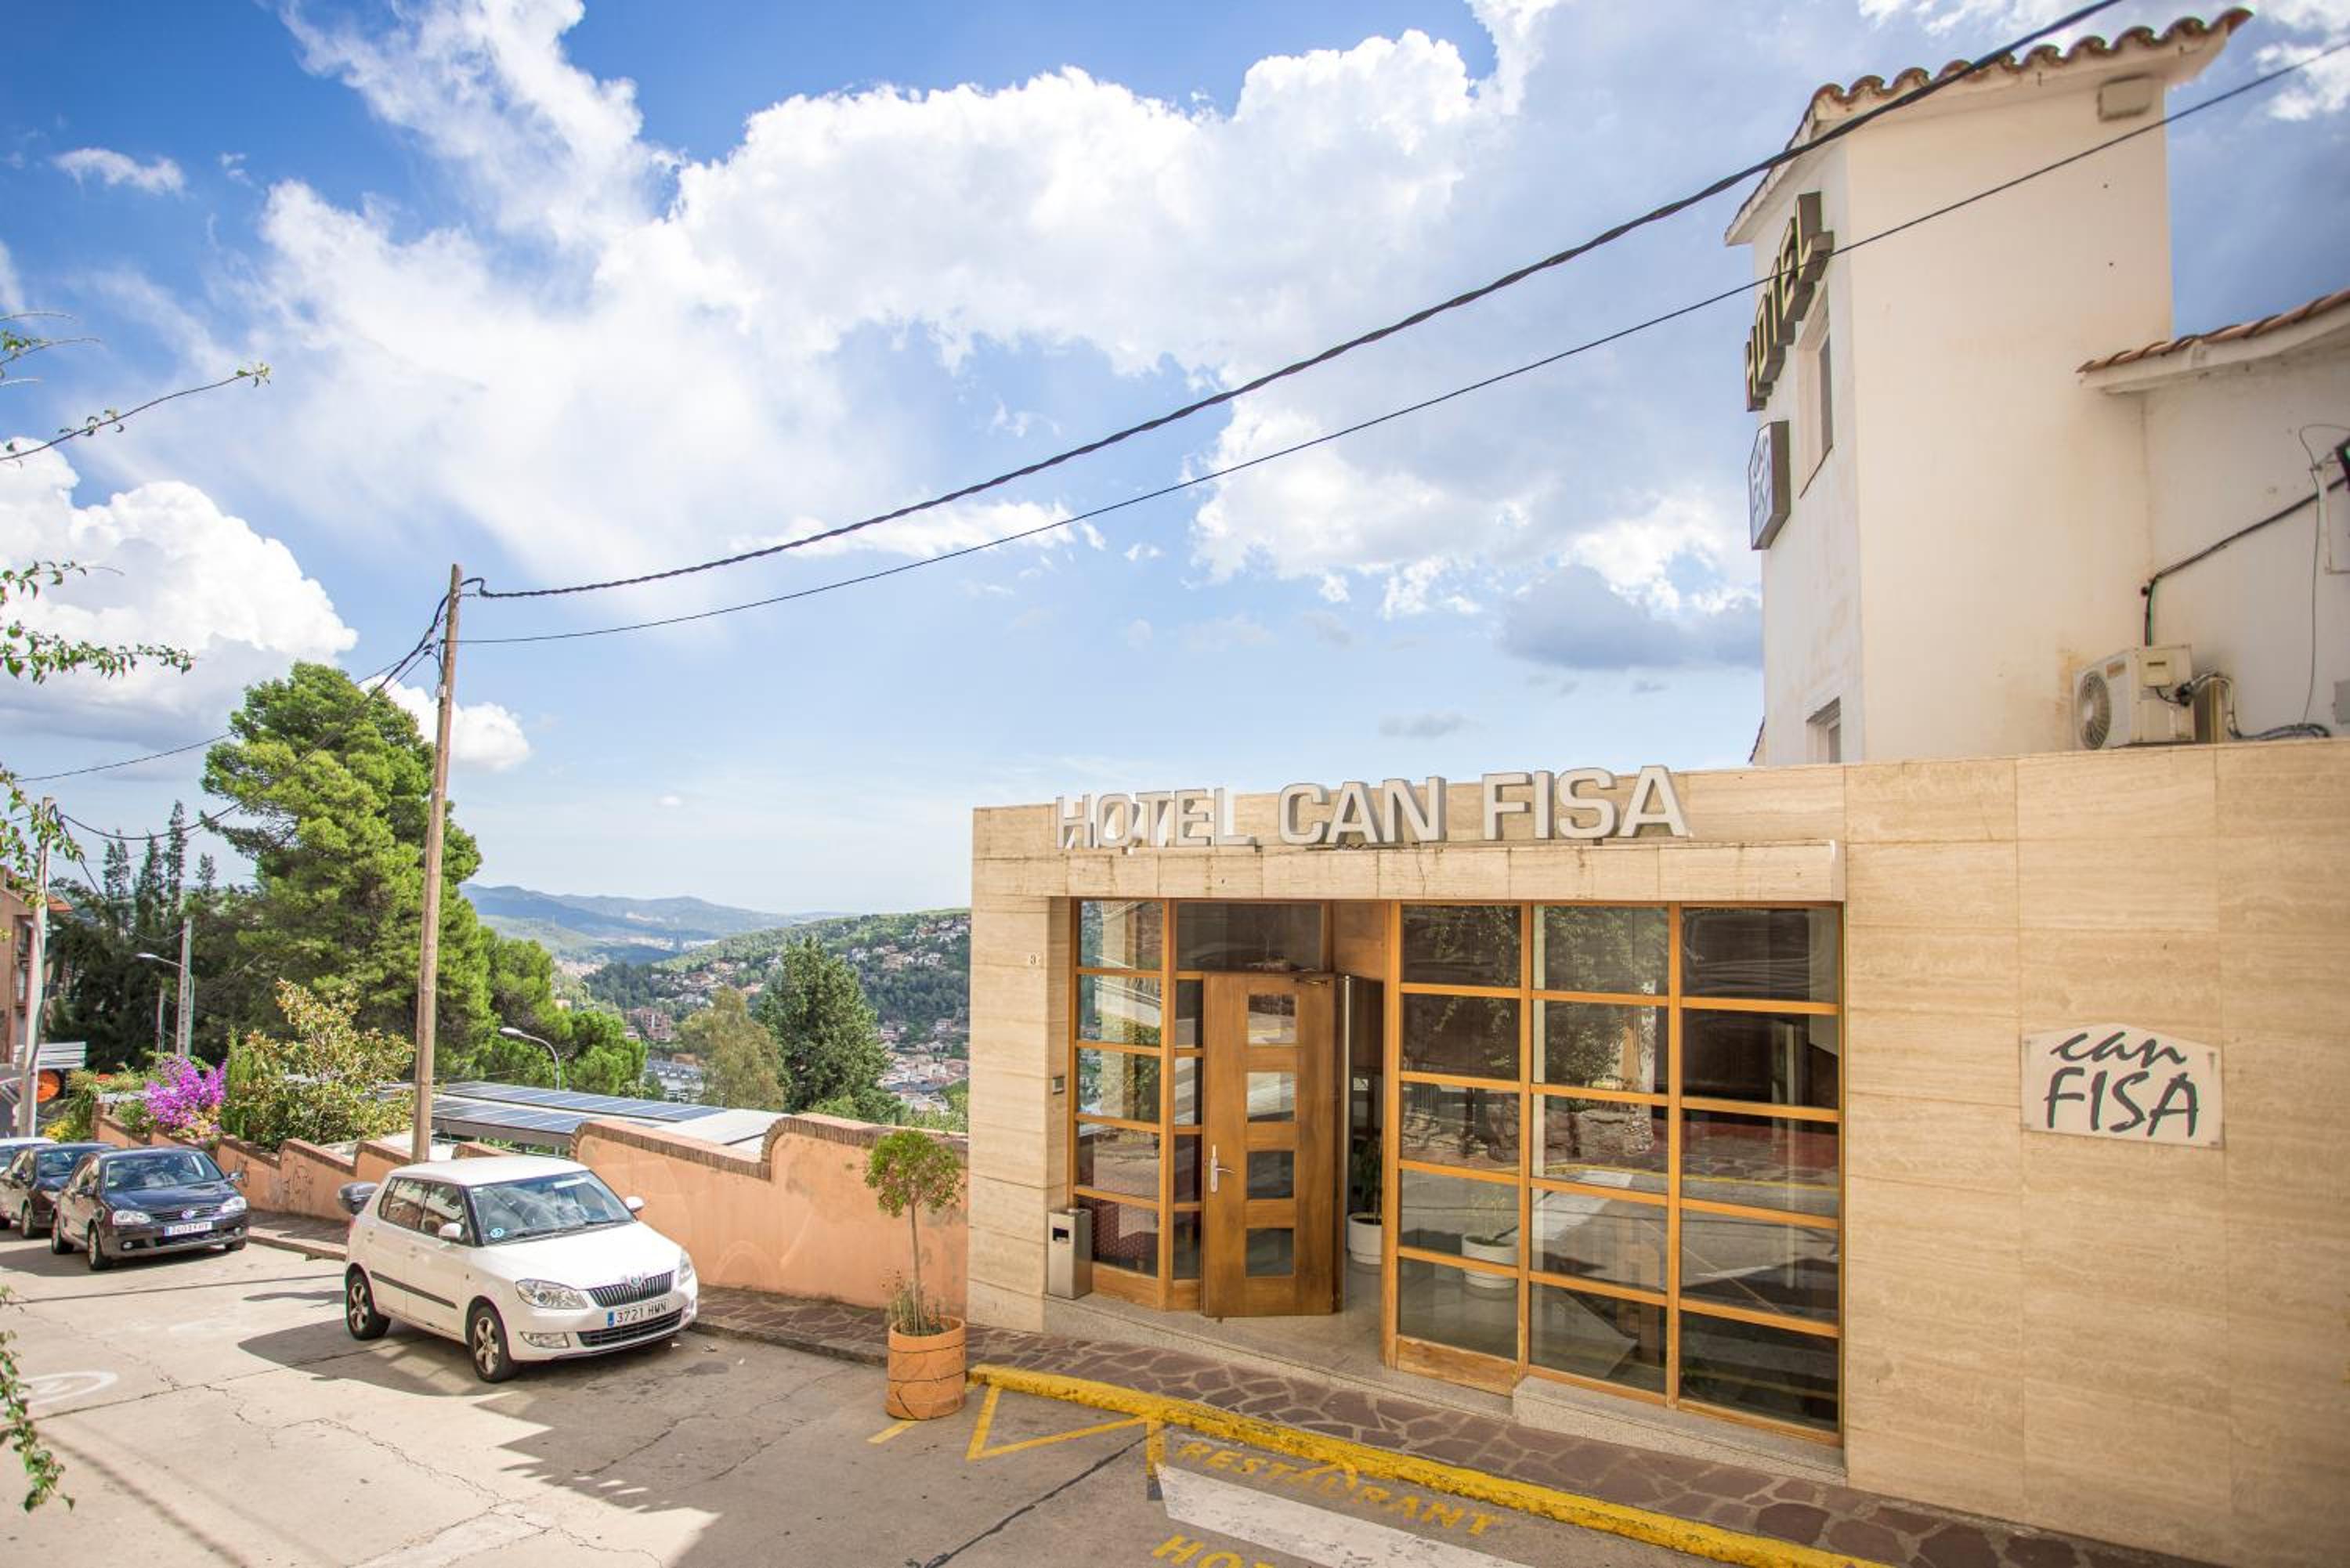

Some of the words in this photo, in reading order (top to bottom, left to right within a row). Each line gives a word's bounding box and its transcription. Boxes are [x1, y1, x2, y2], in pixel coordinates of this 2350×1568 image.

[1055, 787, 1256, 849] HOTEL
[1279, 776, 1446, 844] CAN
[1481, 764, 1690, 840] FISA
[2050, 1031, 2187, 1069] can
[2043, 1066, 2199, 1137] FISA
[616, 1306, 644, 1323] 3721
[1152, 1534, 1277, 1568] HO
